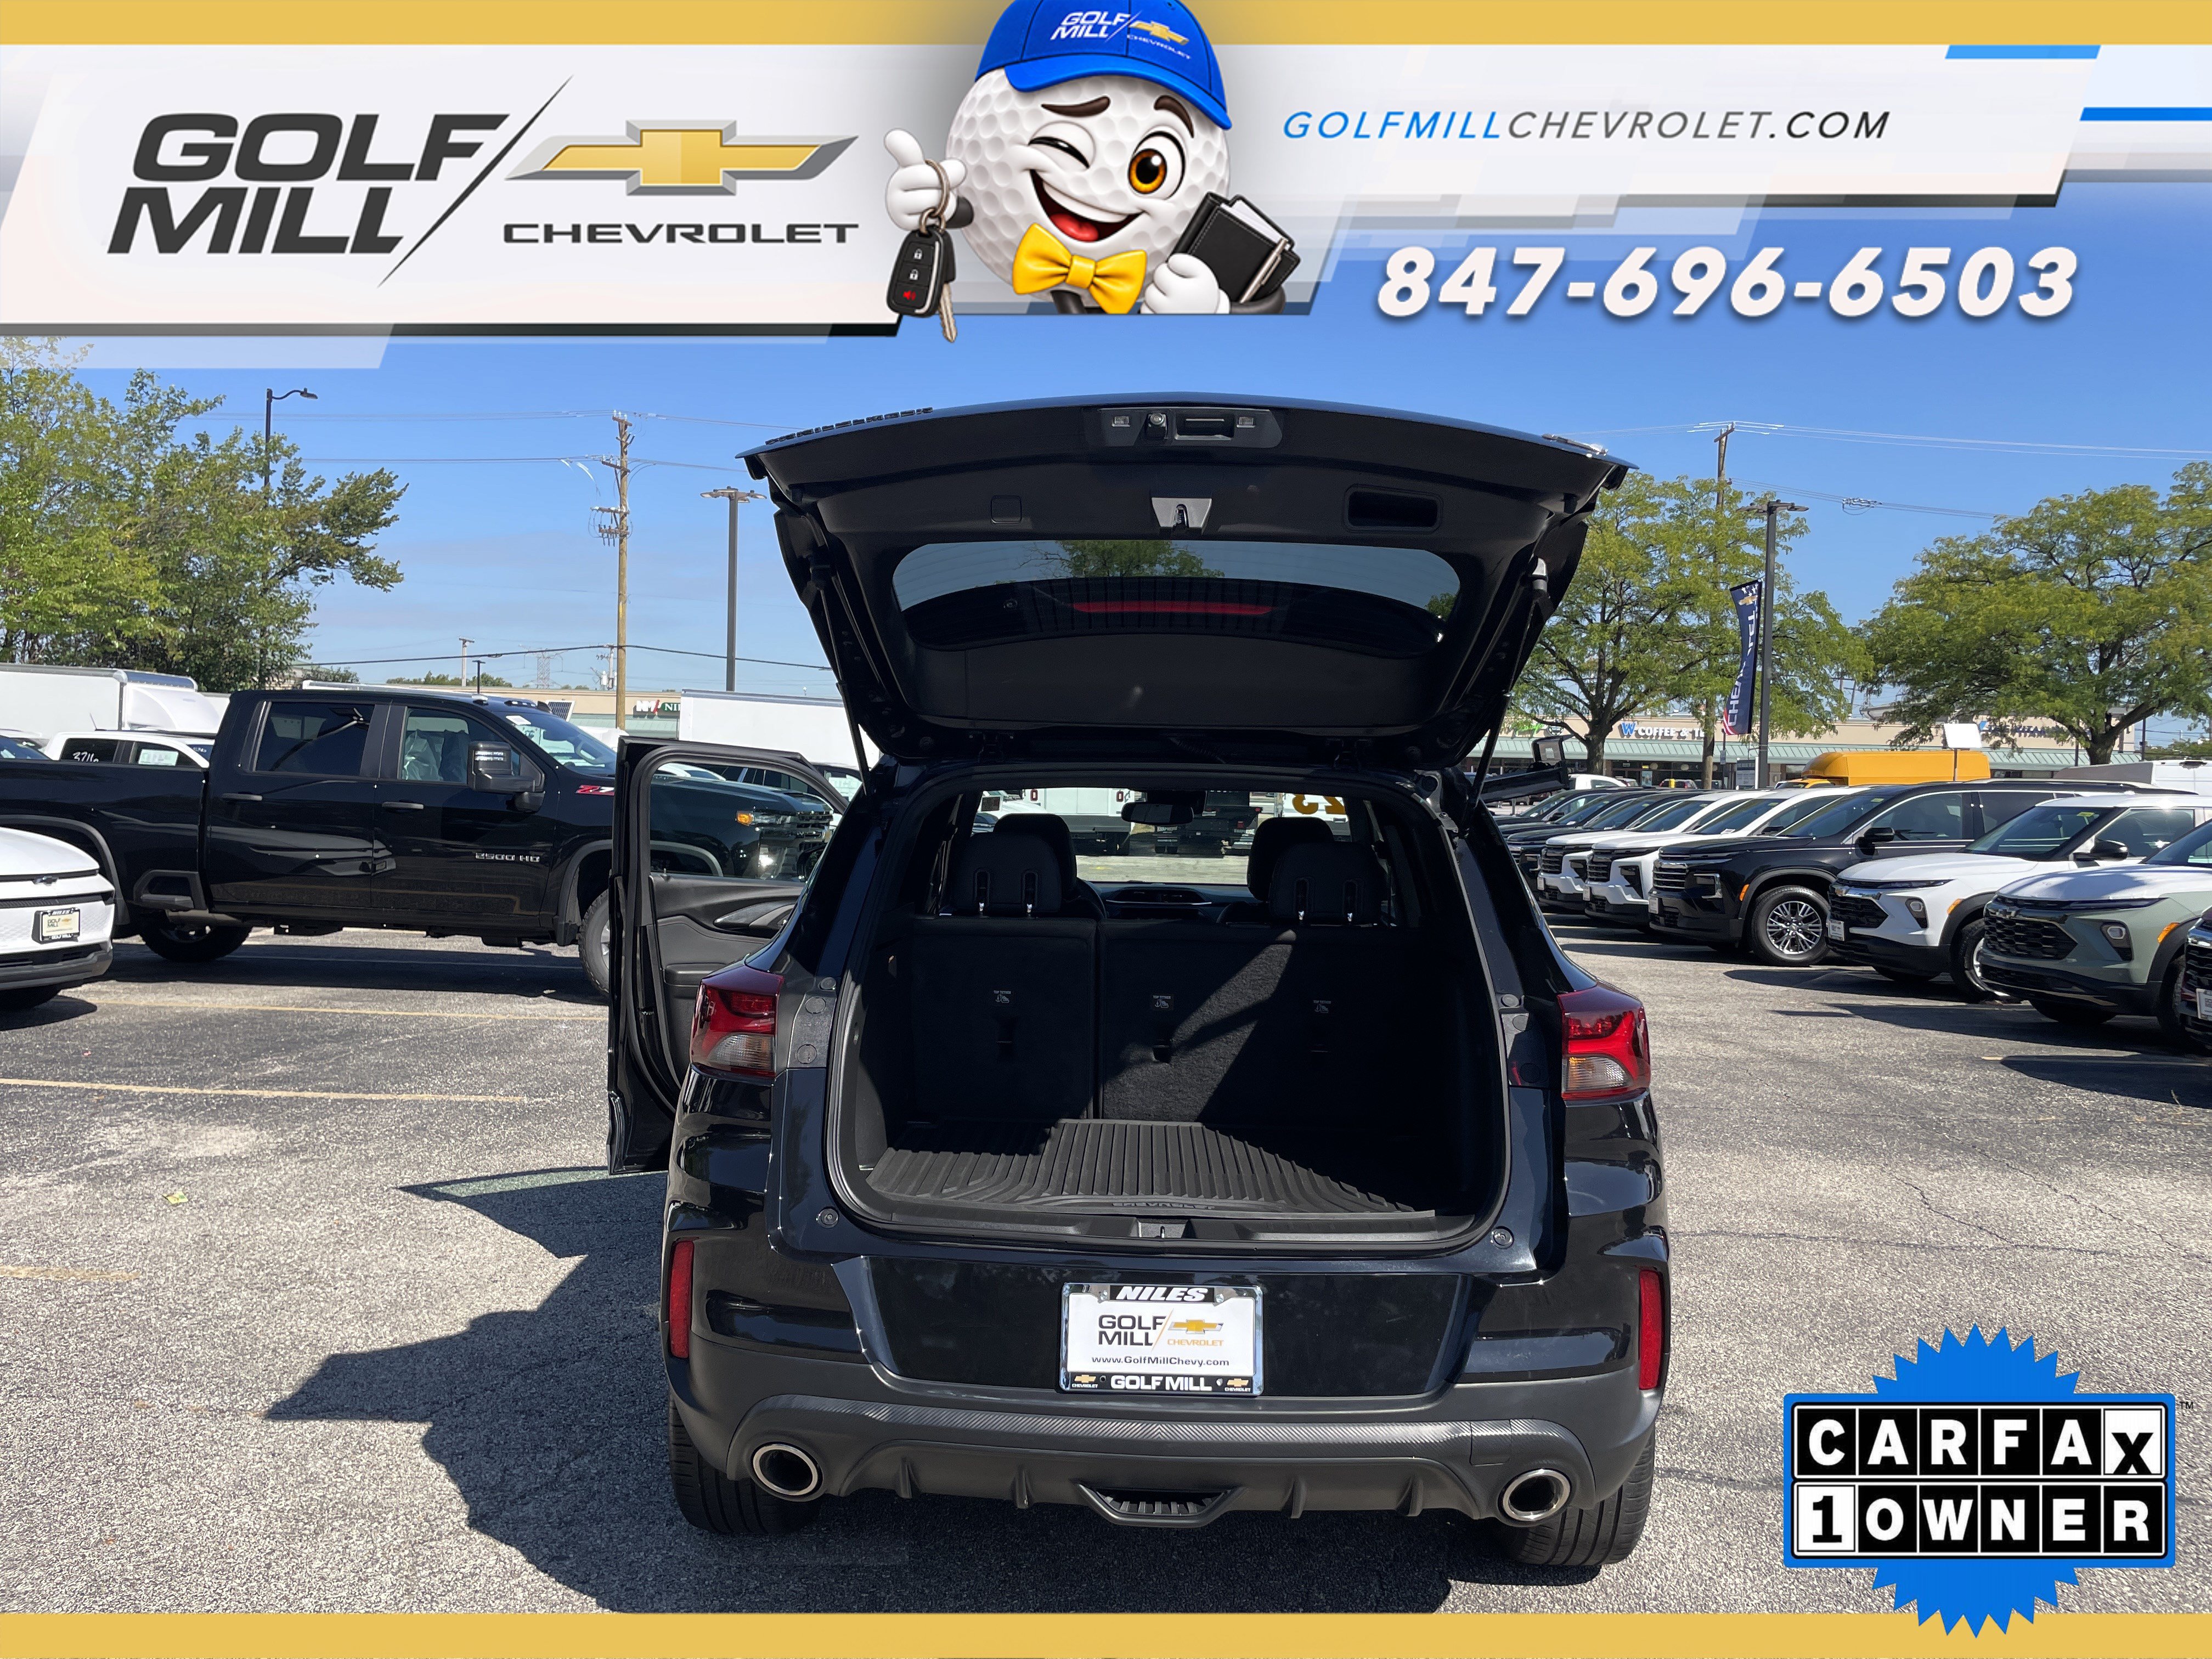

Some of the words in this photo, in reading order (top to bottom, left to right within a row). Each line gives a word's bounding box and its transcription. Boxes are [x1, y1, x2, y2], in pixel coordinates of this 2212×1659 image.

[1621, 723, 1636, 736] W
[1638, 727, 1676, 736] COFFEE
[1680, 728, 1688, 736] &
[476, 852, 515, 861] 2500
[520, 855, 540, 863] HD
[1115, 1286, 1208, 1302] NILES
[1098, 1314, 1167, 1330] GOLF
[1098, 1330, 1153, 1346] MILL
[1092, 1356, 1229, 1367] www.GolfMillChevy.com
[1110, 1375, 1163, 1390] GOLF
[1165, 1376, 1212, 1391] MILL
